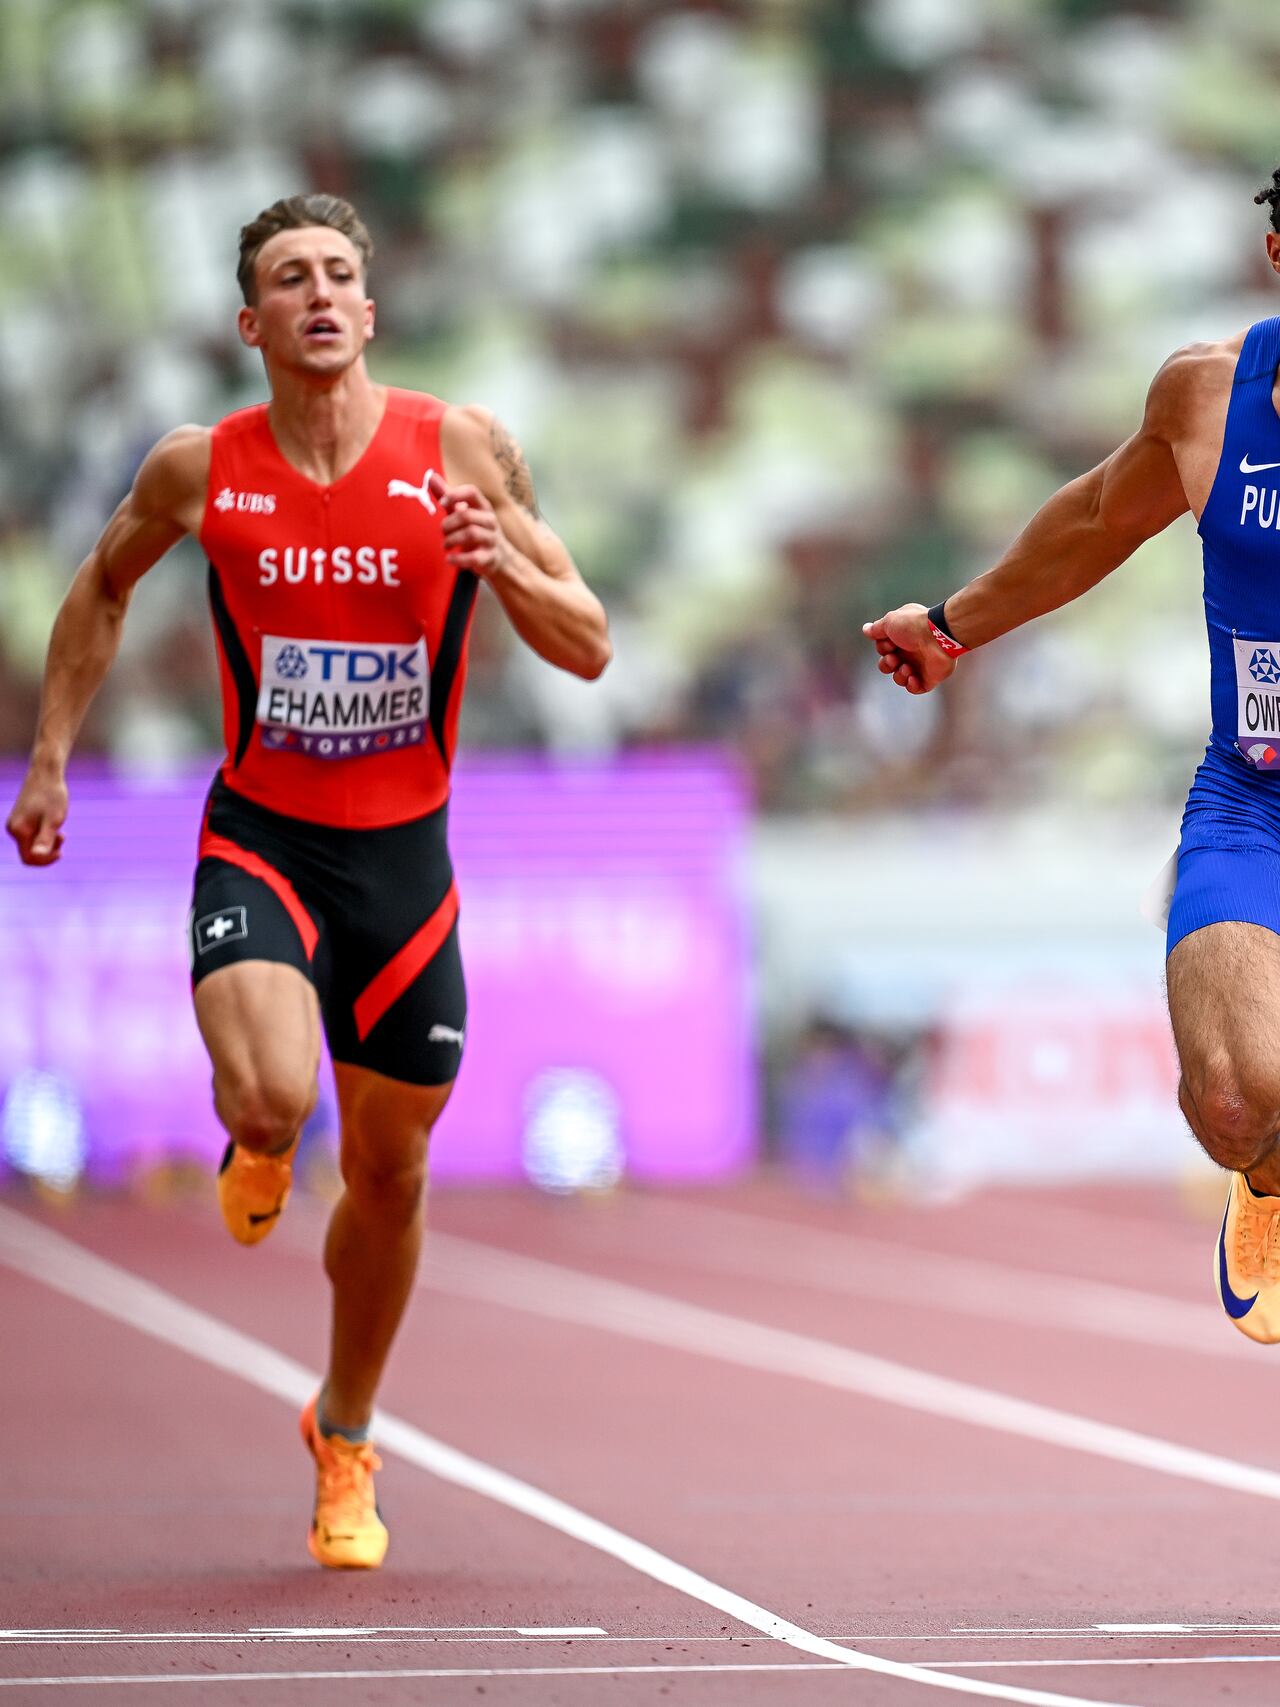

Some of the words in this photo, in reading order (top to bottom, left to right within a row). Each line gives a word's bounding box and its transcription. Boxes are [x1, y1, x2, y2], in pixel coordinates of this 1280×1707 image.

[237, 492, 277, 514] UBS
[309, 647, 420, 683] TDK
[267, 686, 423, 727] EHAMMER
